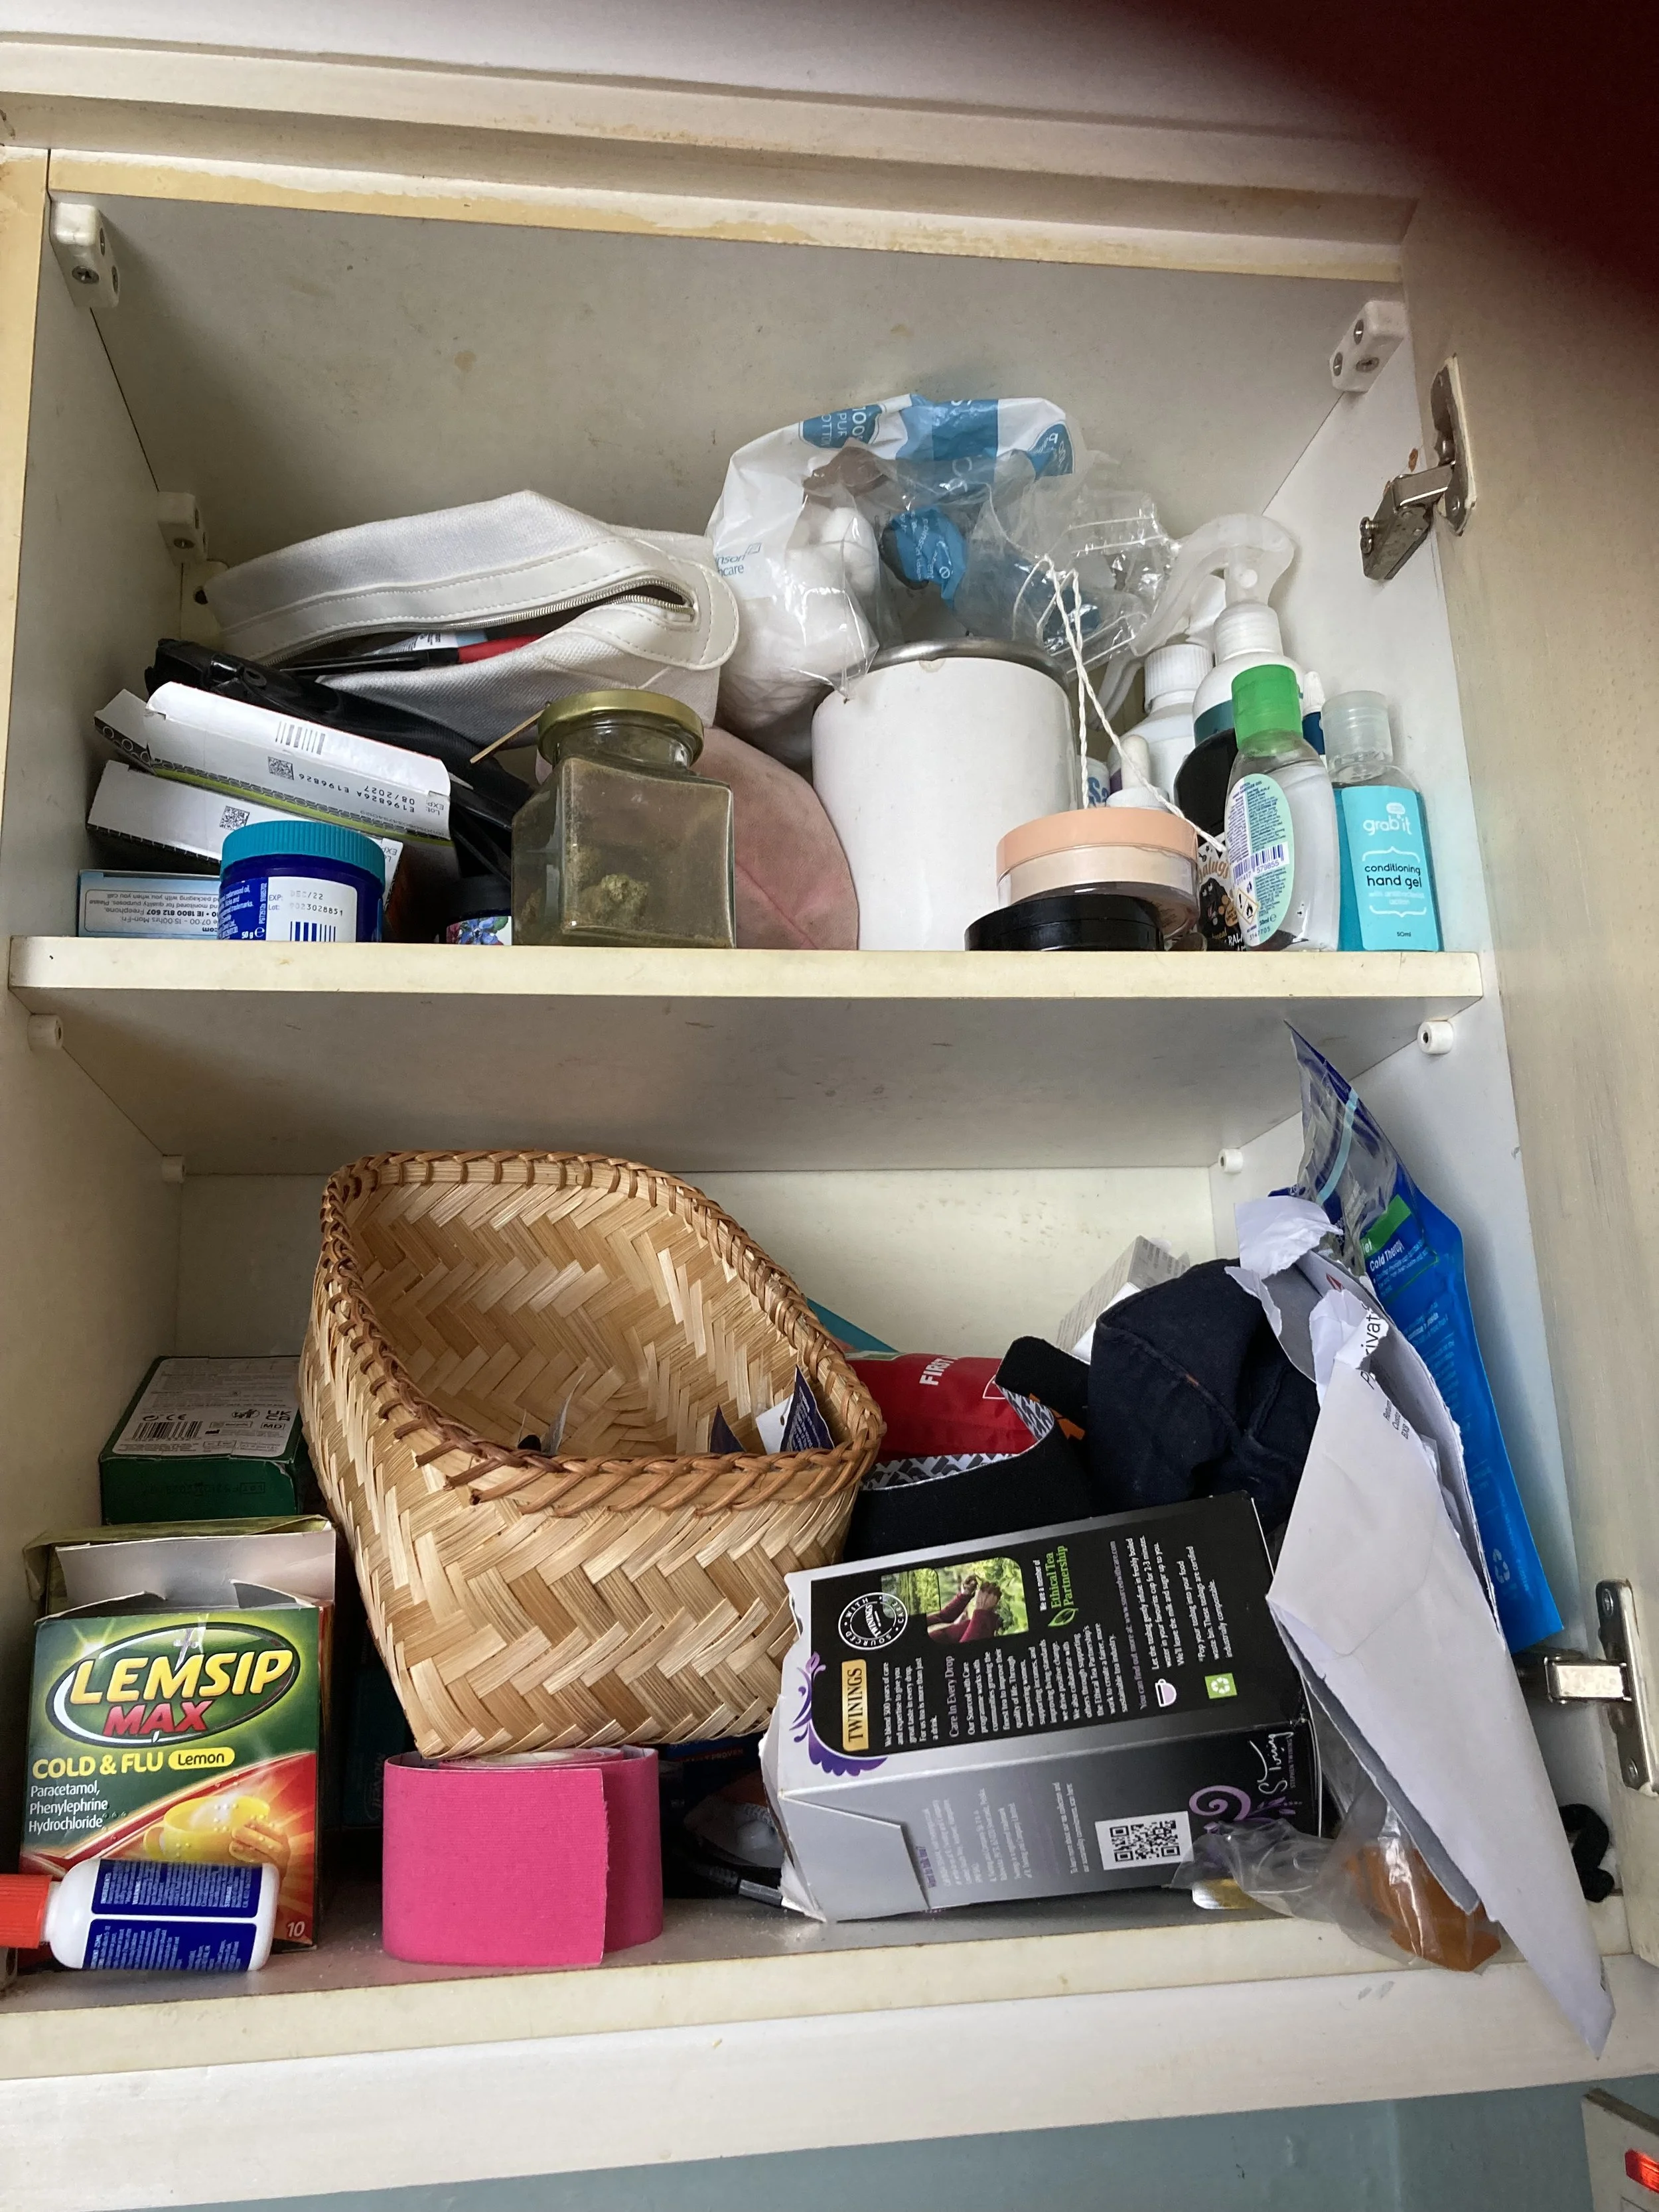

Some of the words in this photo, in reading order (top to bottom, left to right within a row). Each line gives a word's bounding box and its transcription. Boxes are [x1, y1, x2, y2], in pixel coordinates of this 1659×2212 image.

[821, 414, 832, 446] OTTON
[364, 786, 415, 804] 08/2027
[1364, 863, 1421, 876] conditioning
[1366, 875, 1402, 887] hand
[1404, 876, 1422, 890] gel
[1370, 1256, 1386, 1273] Cold
[1384, 1239, 1405, 1258] Therapy
[1125, 1538, 1136, 1557] boiled
[1139, 1535, 1149, 1560] minutes.
[1153, 1542, 1163, 1556] you.
[1045, 1552, 1055, 1572] Tea
[1130, 1557, 1140, 1577] freshly
[1143, 1560, 1152, 1572] 2-3
[1158, 1564, 1166, 1572] up
[1177, 1560, 1187, 1576] food
[1186, 1546, 1198, 1571] certified
[1056, 1546, 1074, 1606] Partnership
[1110, 1541, 1130, 1623] www.sourcedwithcare.com
[1160, 1573, 1169, 1589] sugar
[1182, 1576, 1192, 1591] your
[1046, 1572, 1062, 1608] Ethical
[1136, 1584, 1145, 1603] infuse
[1161, 1590, 1171, 1602] and
[1196, 1583, 1206, 1606] teabags
[845, 1597, 869, 1617] WITH
[1152, 1593, 1163, 1623] favourite
[1165, 1603, 1175, 1617] milk
[1208, 1580, 1224, 1621] compostable.
[866, 1603, 881, 1638] TWININGS
[893, 1600, 904, 1625] CARE
[1139, 1603, 1152, 1623] gently
[1189, 1605, 1198, 1627] teabag
[1202, 1607, 1212, 1627] These
[845, 1629, 891, 1647] SOURCED
[1145, 1623, 1154, 1645] teabag
[1158, 1623, 1168, 1639] your
[1173, 1630, 1181, 1647] leave
[1194, 1627, 1204, 1643] your
[1205, 1626, 1215, 1639] bin.
[1218, 1622, 1232, 1657] industrially
[1130, 1653, 1139, 1665] out
[1163, 1648, 1172, 1668] water
[1175, 1647, 1185, 1666] We'll
[1210, 1639, 1219, 1660] waste
[944, 1655, 954, 1678] Drop
[1132, 1665, 1141, 1680] find
[69, 1649, 295, 1706] LEMSIP
[882, 1675, 889, 1684] of
[894, 1680, 903, 1694] give
[946, 1679, 956, 1704] Every
[846, 1666, 863, 1741] TWININGS
[948, 1704, 957, 1715] In
[102, 1699, 214, 1738] MAX
[895, 1702, 904, 1732] expertise
[949, 1716, 959, 1737] Care
[885, 1735, 892, 1747] We
[908, 1726, 917, 1743] great
[32, 1757, 96, 1779] COLD
[99, 1754, 119, 1775] &
[121, 1751, 163, 1773] FLU
[177, 1751, 225, 1767] Lemon
[30, 1780, 100, 1797] Paracetamol,
[30, 1797, 108, 1816] Phenylephrine
[29, 1814, 104, 1833] Hydrochloride
[287, 1921, 305, 1938] 10
